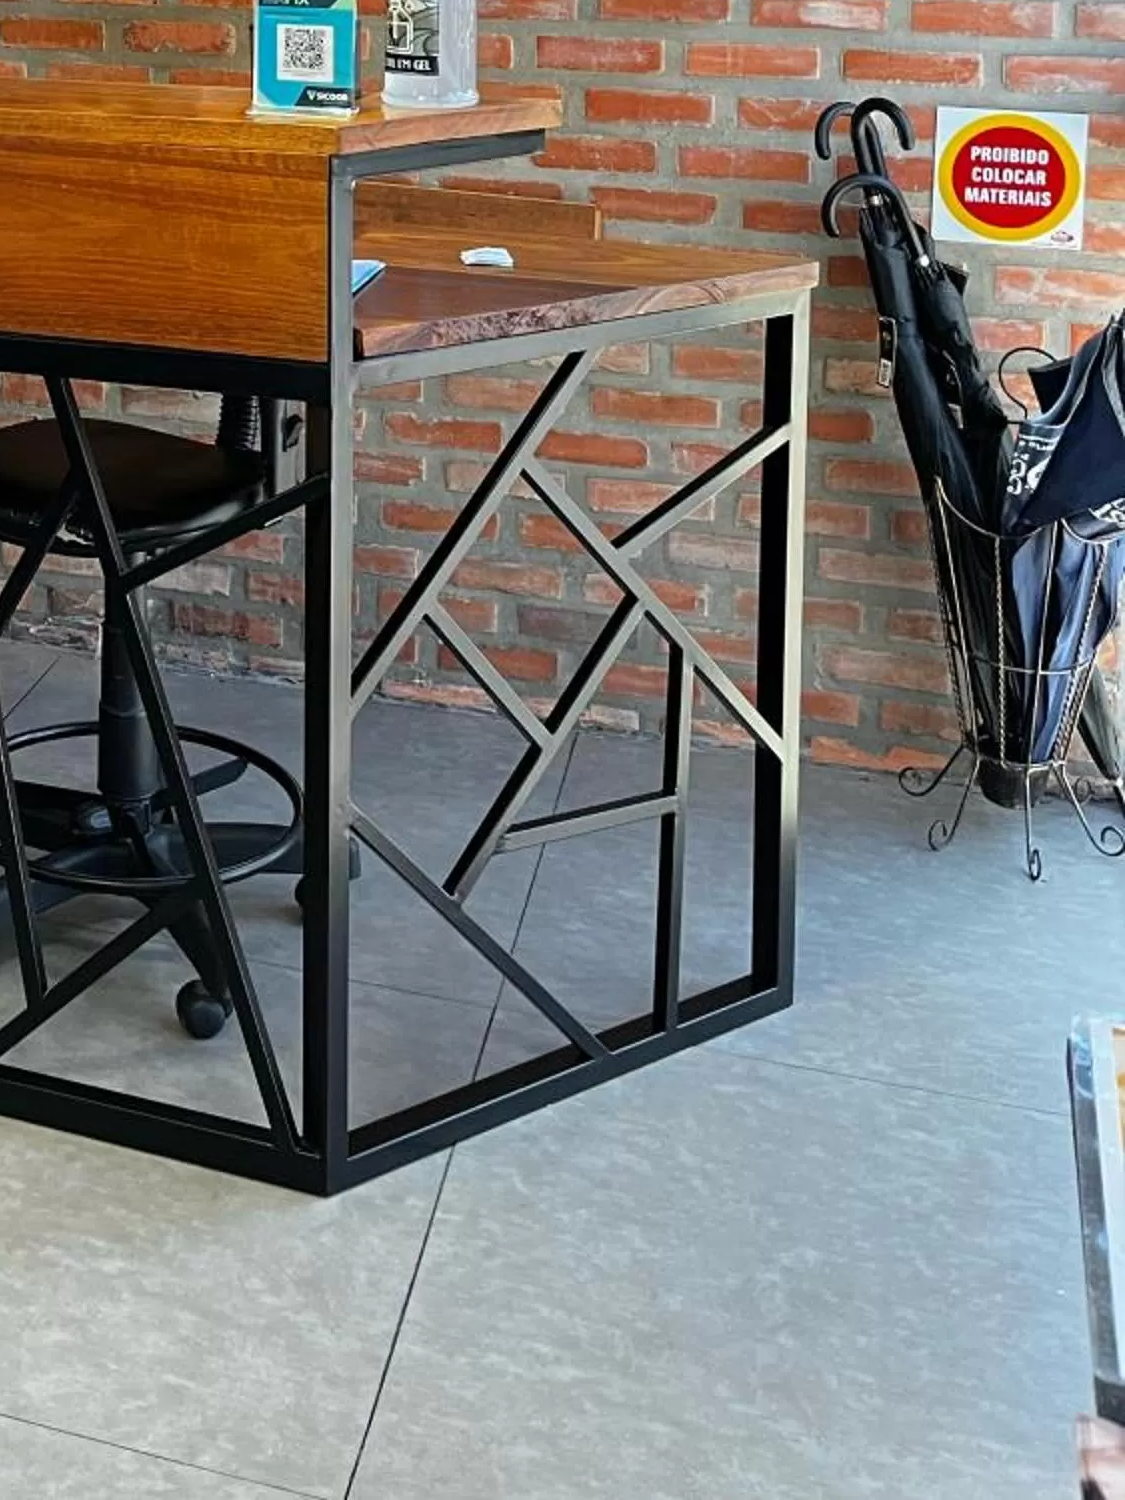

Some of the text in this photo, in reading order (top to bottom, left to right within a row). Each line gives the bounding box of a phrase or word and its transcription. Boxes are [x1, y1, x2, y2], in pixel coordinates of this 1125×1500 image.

[970, 145, 1050, 165] PROIBIDO
[971, 166, 1047, 186] COLOCAR
[963, 187, 1052, 207] MATERIAIS
